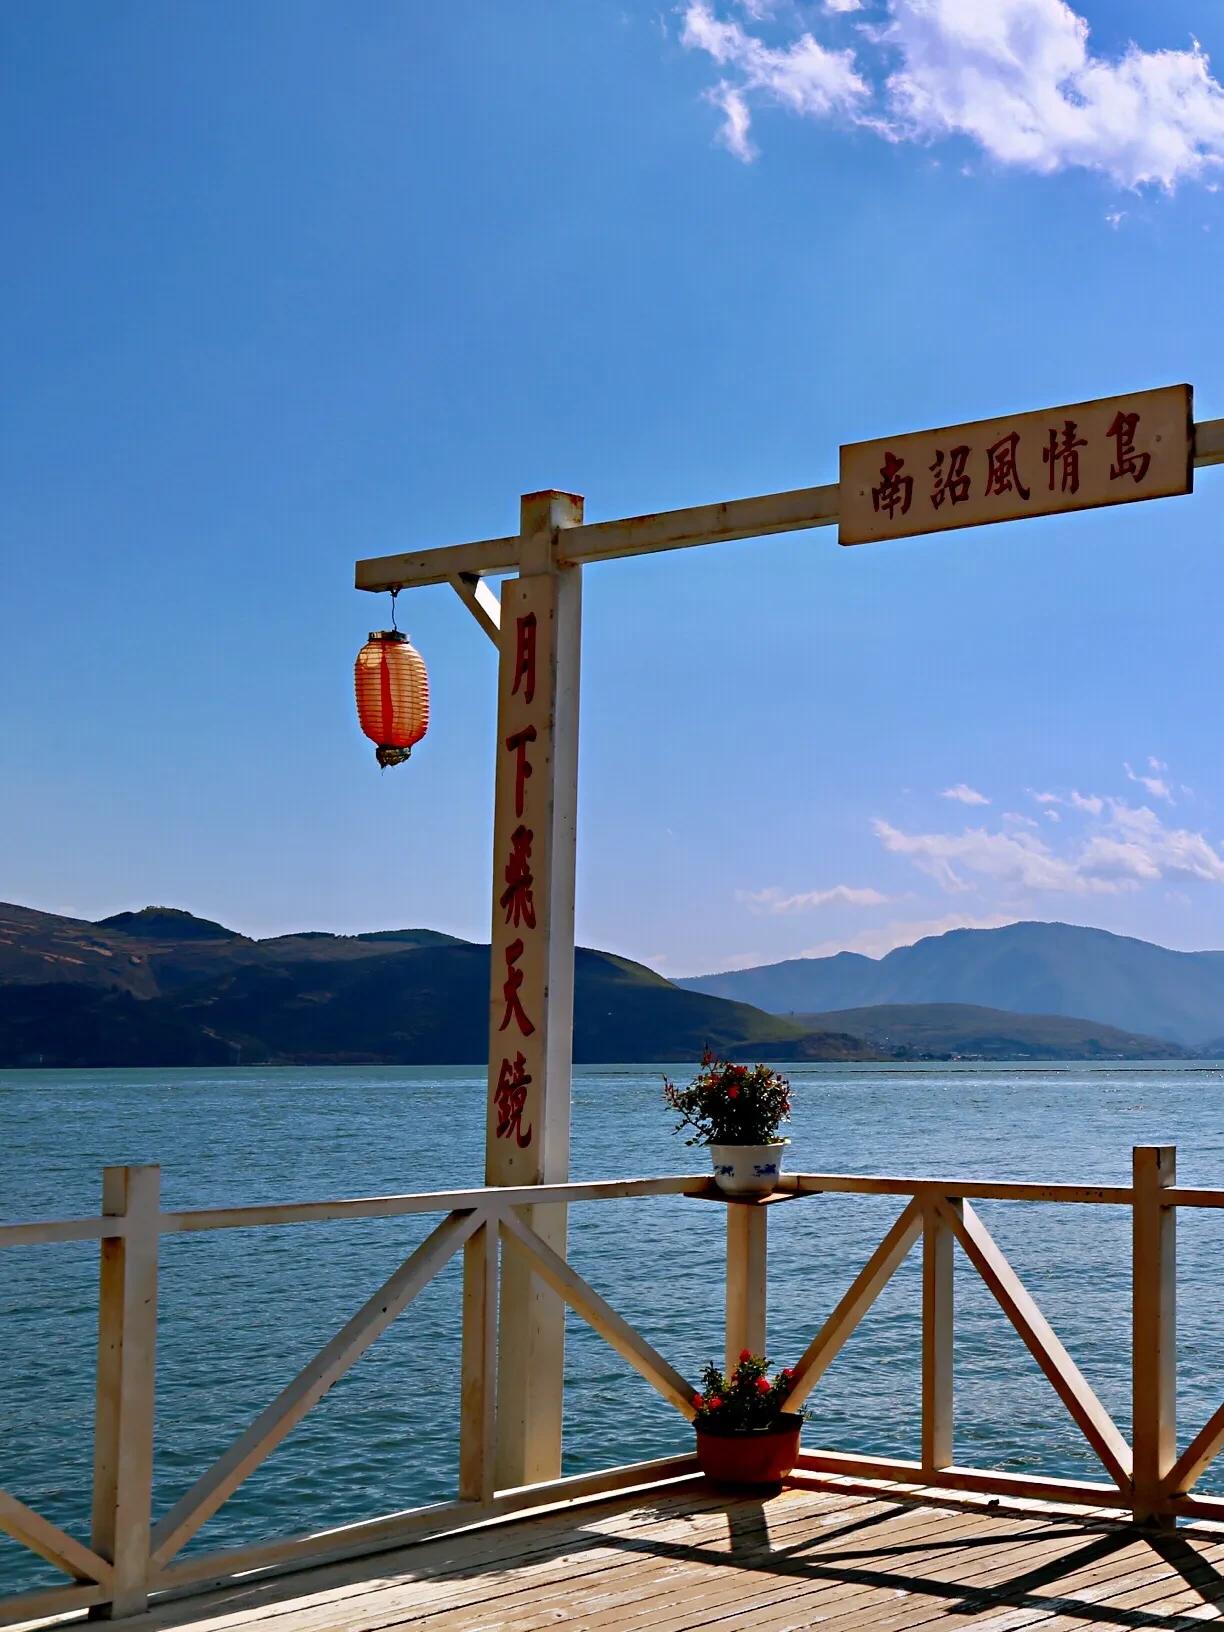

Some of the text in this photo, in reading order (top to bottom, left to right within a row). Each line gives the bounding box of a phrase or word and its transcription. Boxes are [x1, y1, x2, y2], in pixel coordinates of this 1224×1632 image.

[872, 411, 1150, 520] 南詔風情島
